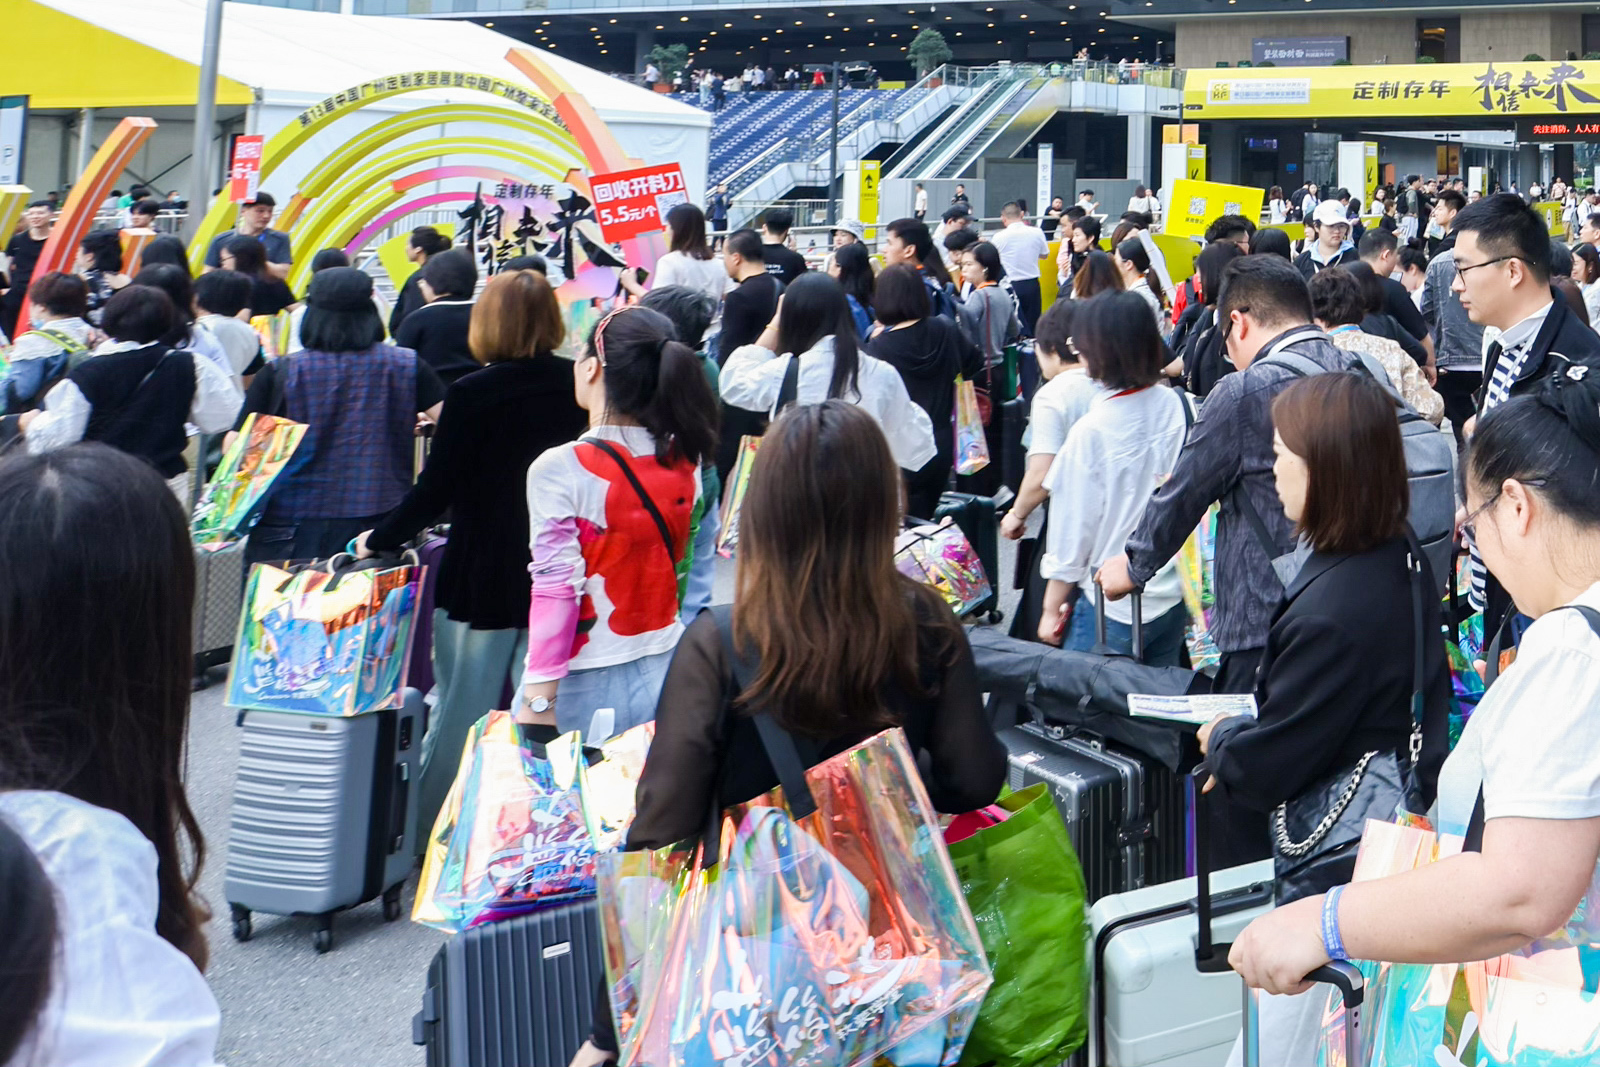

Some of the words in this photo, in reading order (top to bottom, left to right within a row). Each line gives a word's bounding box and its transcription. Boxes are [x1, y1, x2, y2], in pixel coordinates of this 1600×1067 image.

[1353, 80, 1450, 100] 定制存年
[494, 183, 556, 200] 定制存年
[593, 171, 683, 203] 回收开料刀
[600, 205, 657, 226] 5.5元/个
